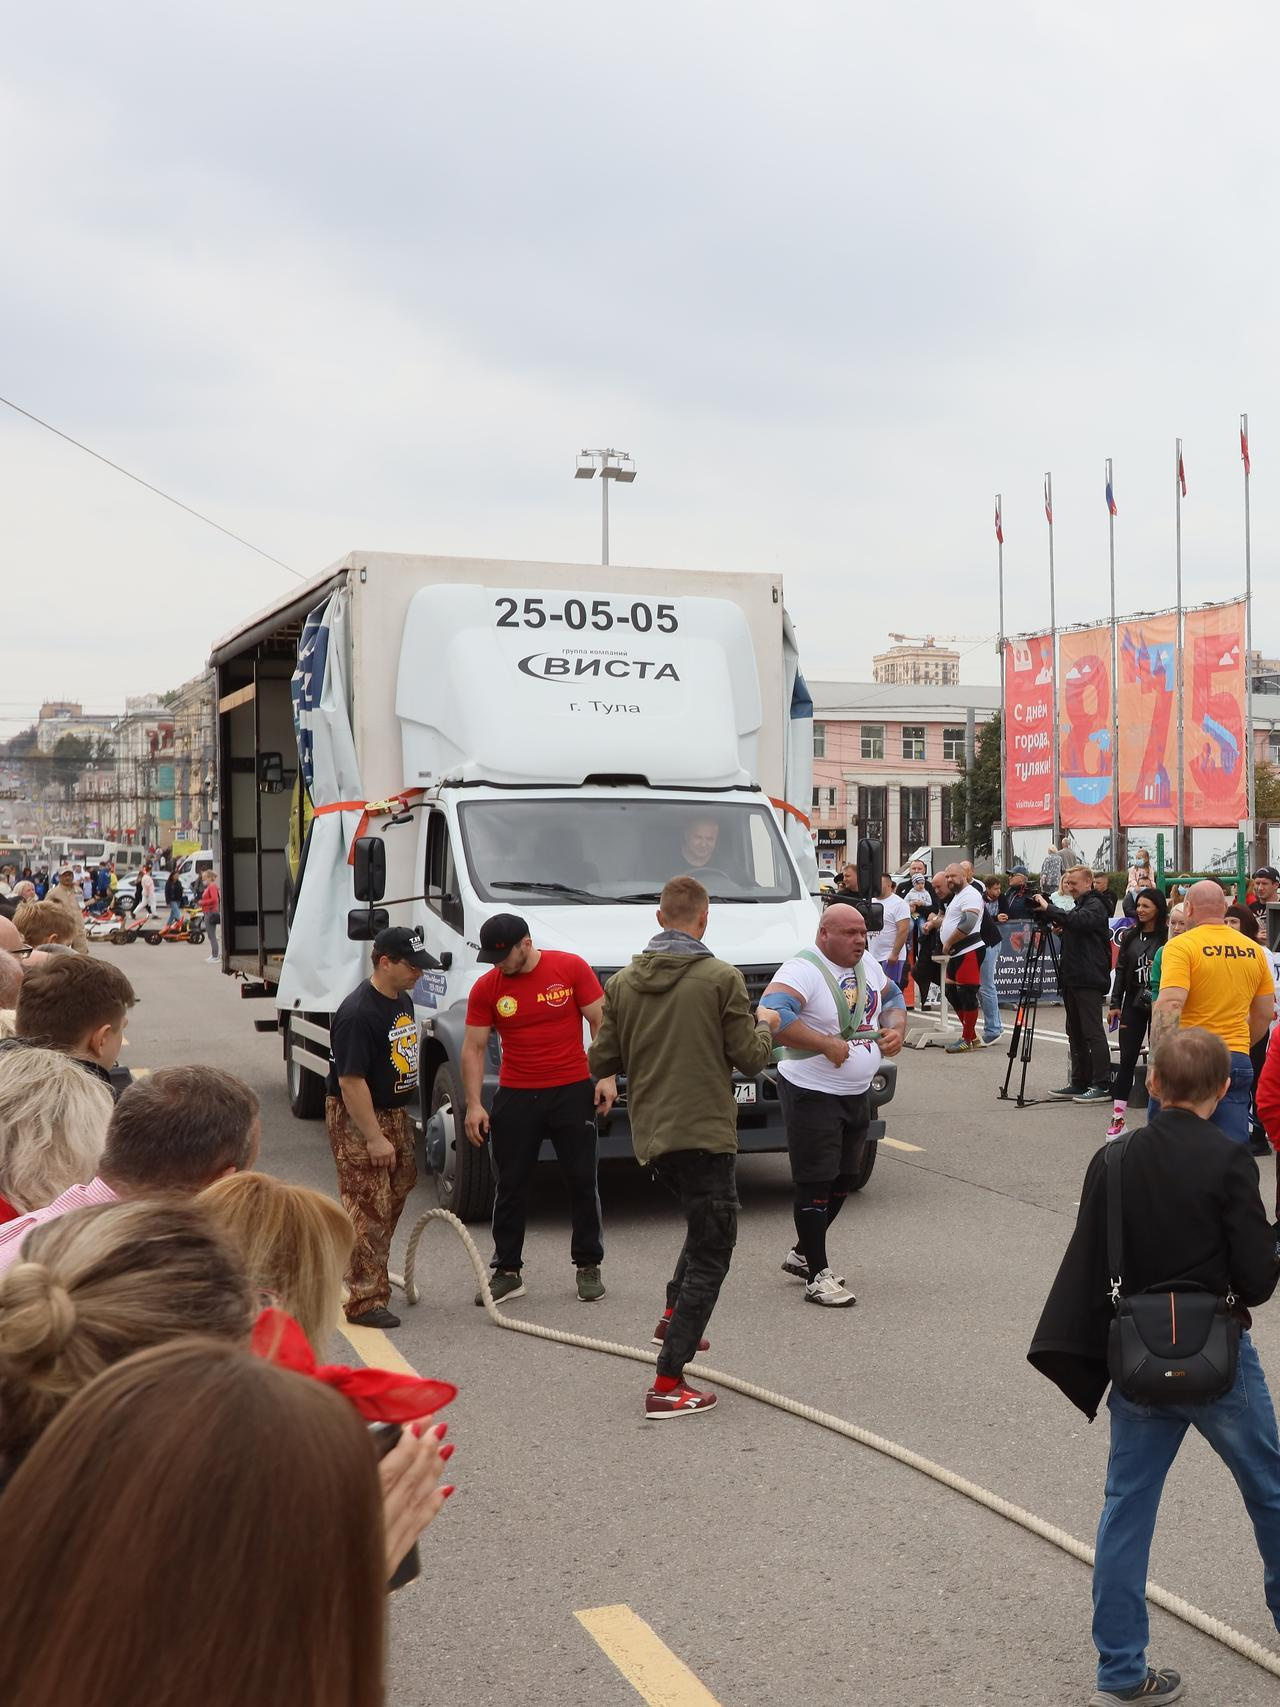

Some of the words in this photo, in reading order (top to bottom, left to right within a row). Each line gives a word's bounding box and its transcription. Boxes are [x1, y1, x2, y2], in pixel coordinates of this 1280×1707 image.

[495, 597, 679, 633] 25-05-05
[562, 648, 588, 656] группа
[590, 649, 628, 657] компаний
[543, 657, 681, 682] ВИСТА
[569, 702, 581, 712] г.
[588, 700, 641, 715] Тула
[1014, 703, 1023, 720] С
[1014, 731, 1050, 752] города,
[1014, 756, 1051, 782] туляки!
[1202, 945, 1256, 959] СУДЬЯ
